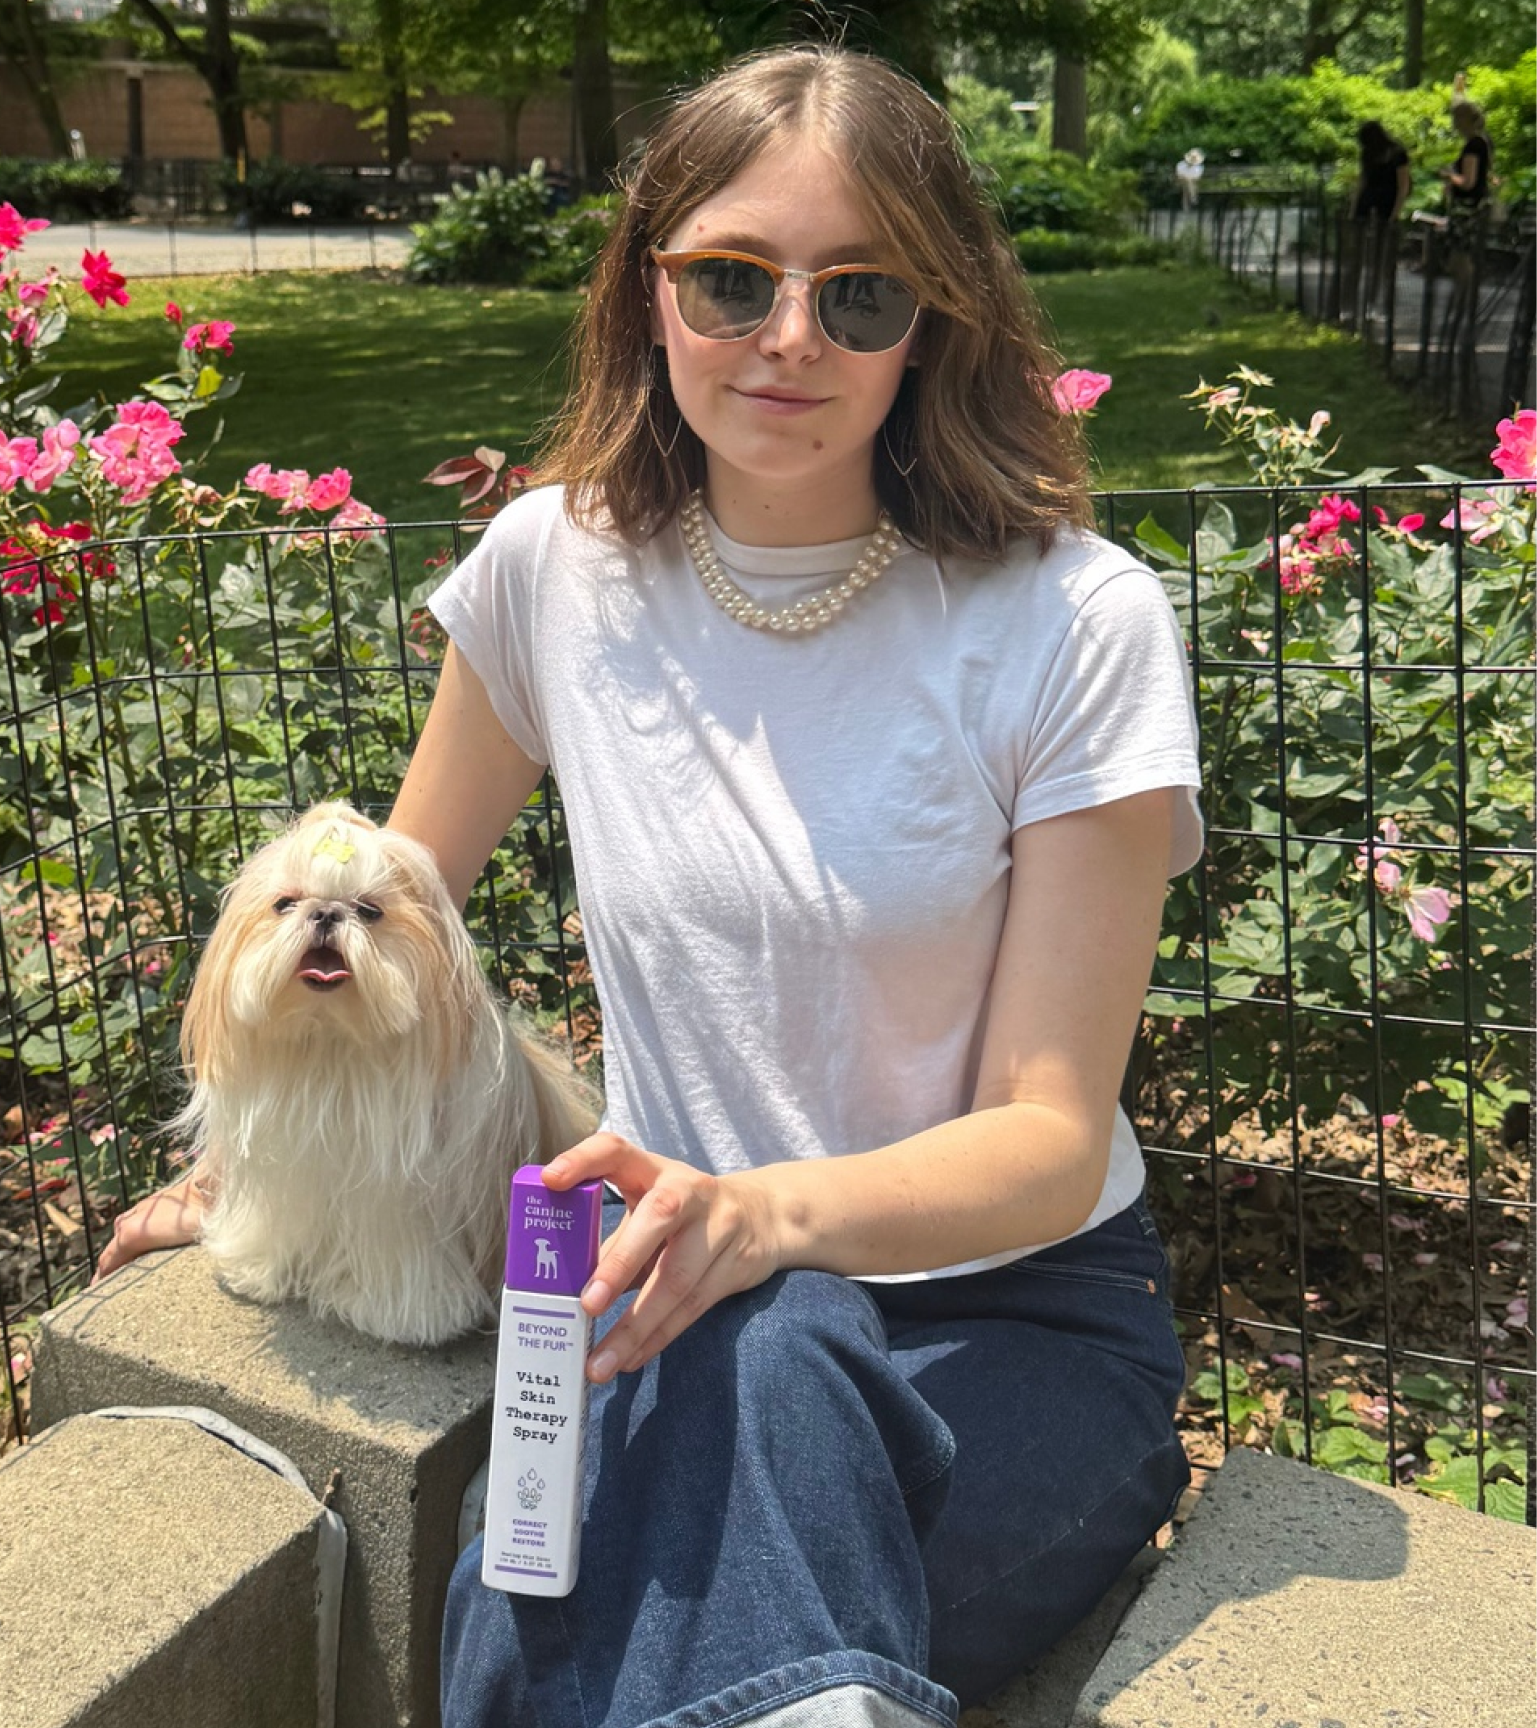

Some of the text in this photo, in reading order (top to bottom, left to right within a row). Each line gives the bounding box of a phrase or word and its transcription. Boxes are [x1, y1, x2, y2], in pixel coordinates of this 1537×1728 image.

[526, 1195, 542, 1205] the
[524, 1205, 573, 1219] canine
[524, 1216, 572, 1231] project
[518, 1322, 567, 1337] BEYOND
[518, 1336, 541, 1348] THE
[516, 1371, 561, 1387] Vital
[520, 1390, 555, 1405] Skin
[505, 1406, 568, 1427] Therapy
[512, 1426, 557, 1444] Spray
[512, 1518, 547, 1529] CORRECT
[512, 1537, 546, 1547] RESTORE
